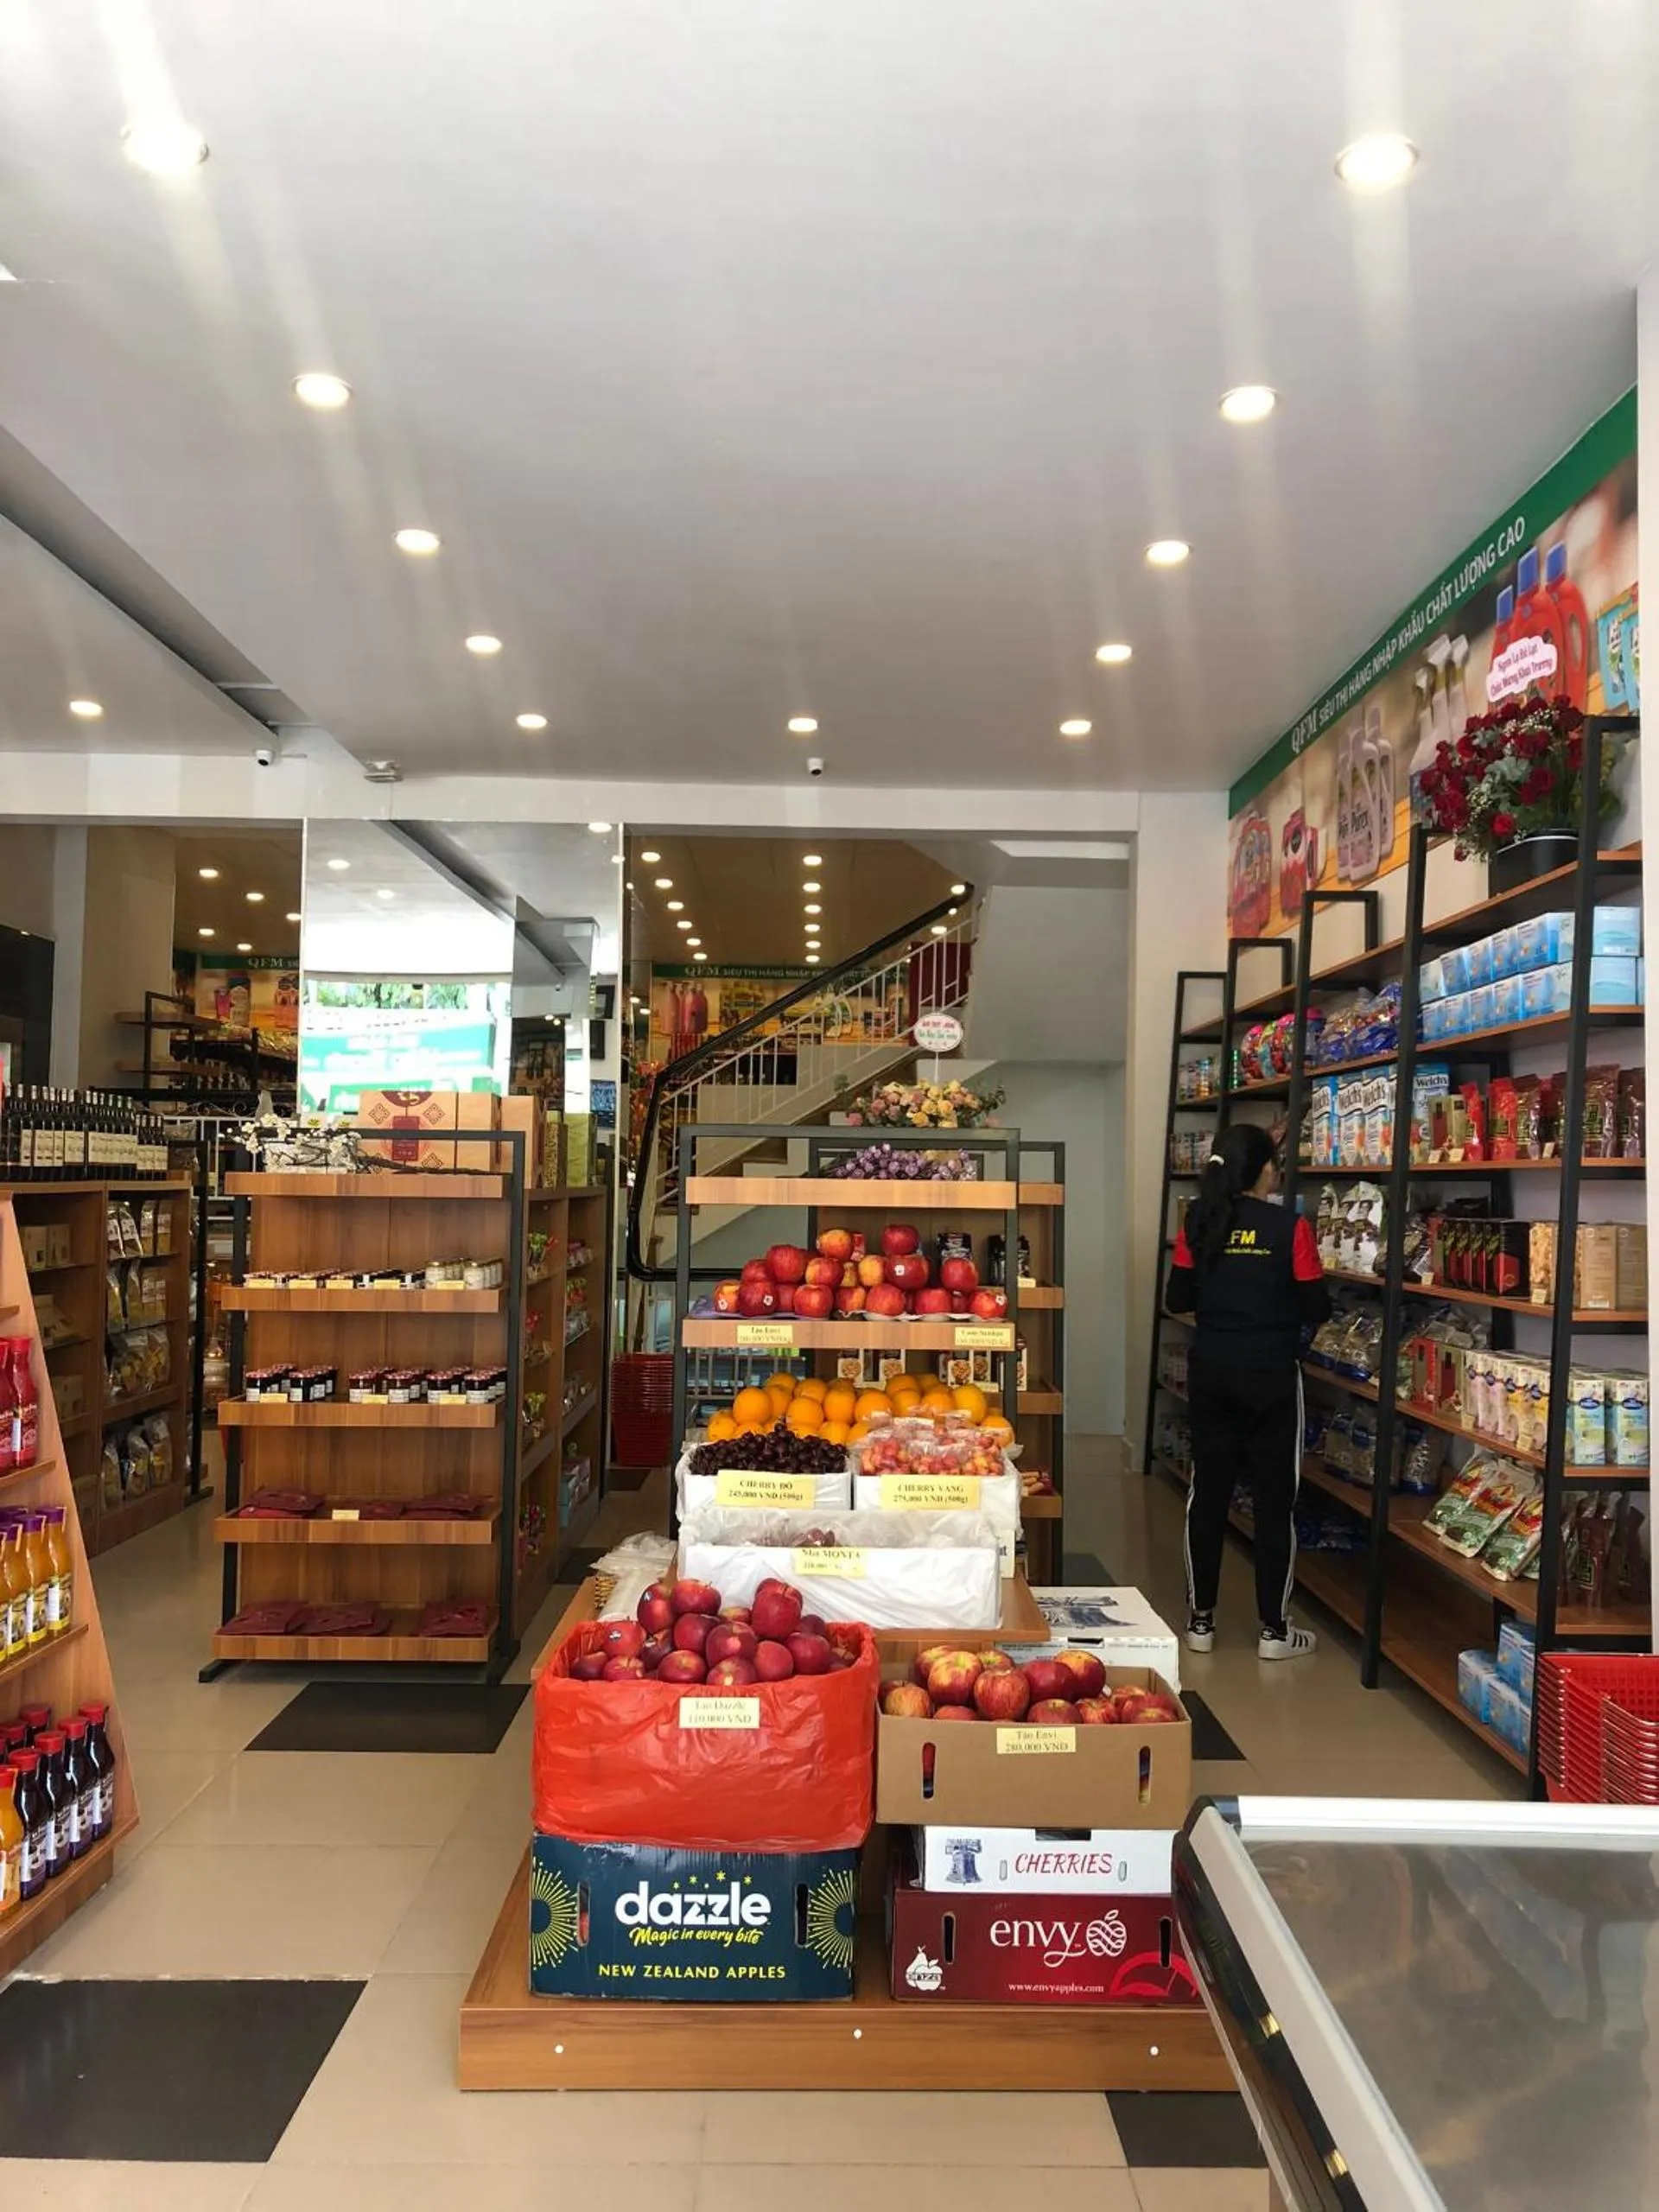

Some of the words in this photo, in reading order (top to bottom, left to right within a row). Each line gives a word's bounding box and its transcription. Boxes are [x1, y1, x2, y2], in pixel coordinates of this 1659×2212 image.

[1292, 708, 1317, 753] QFM
[1373, 638, 1397, 677] NHẬP
[1427, 581, 1452, 624] CHẤT
[1454, 543, 1496, 600] LƯỢNG
[1497, 516, 1525, 556] CAO
[248, 957, 283, 969] QFM
[684, 965, 720, 976] QFM
[1230, 1230, 1256, 1244] FM
[740, 1479, 776, 1490] CHERRY
[898, 1484, 935, 1492] CHERRY
[1014, 1853, 1113, 1874] CHERRIES
[614, 1880, 772, 1926] dazzle
[629, 1925, 680, 1948] Magic
[680, 1928, 695, 1941] in
[695, 1929, 734, 1948] every
[734, 1926, 765, 1945] bite
[989, 1919, 1087, 1968] envy
[598, 1964, 637, 1977] NEW
[642, 1964, 720, 1979] ZEALAND
[726, 1966, 786, 1979] APPLES
[1007, 1982, 1105, 1995] www.envyapples.com
